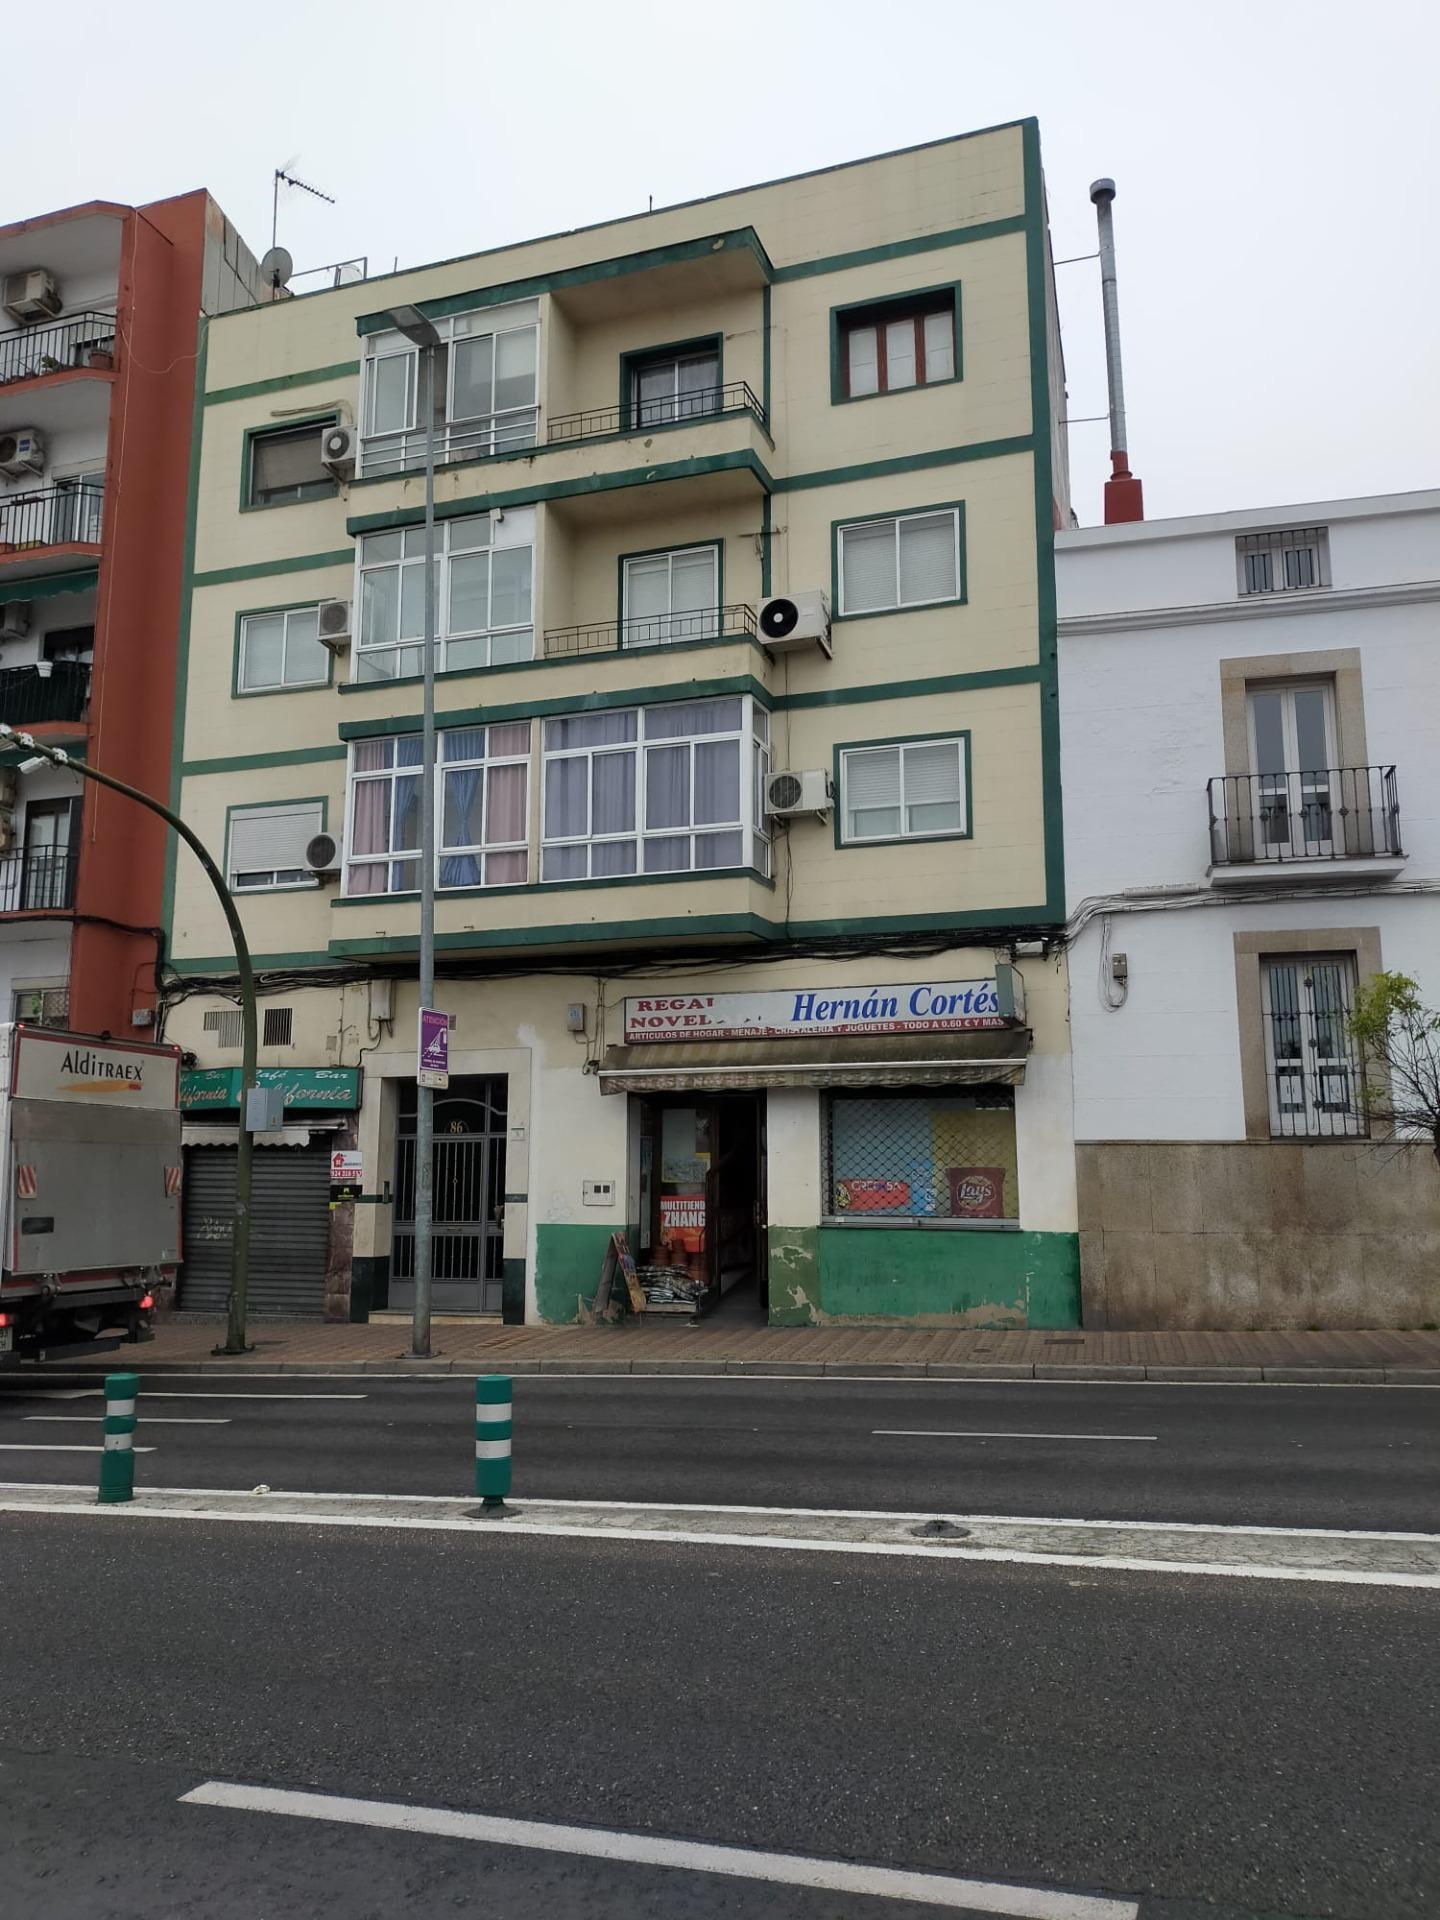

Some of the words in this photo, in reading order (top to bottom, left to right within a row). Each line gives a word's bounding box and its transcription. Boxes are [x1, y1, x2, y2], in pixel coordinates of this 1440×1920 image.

[791, 988, 898, 1021] Hernán
[909, 983, 999, 1016] Cortés
[629, 1031, 677, 1040] ARTICULOS
[693, 1029, 723, 1038] HOGAR
[731, 1027, 767, 1036] MENAJE
[845, 1022, 894, 1031] JUGUETES
[904, 1020, 929, 1029] TODO
[932, 1019, 938, 1028] A
[941, 1018, 961, 1028] 0.60
[974, 1018, 980, 1026] Y
[315, 1070, 349, 1079] Bar
[450, 1120, 463, 1135] 86
[664, 1211, 706, 1227] ZHANG
